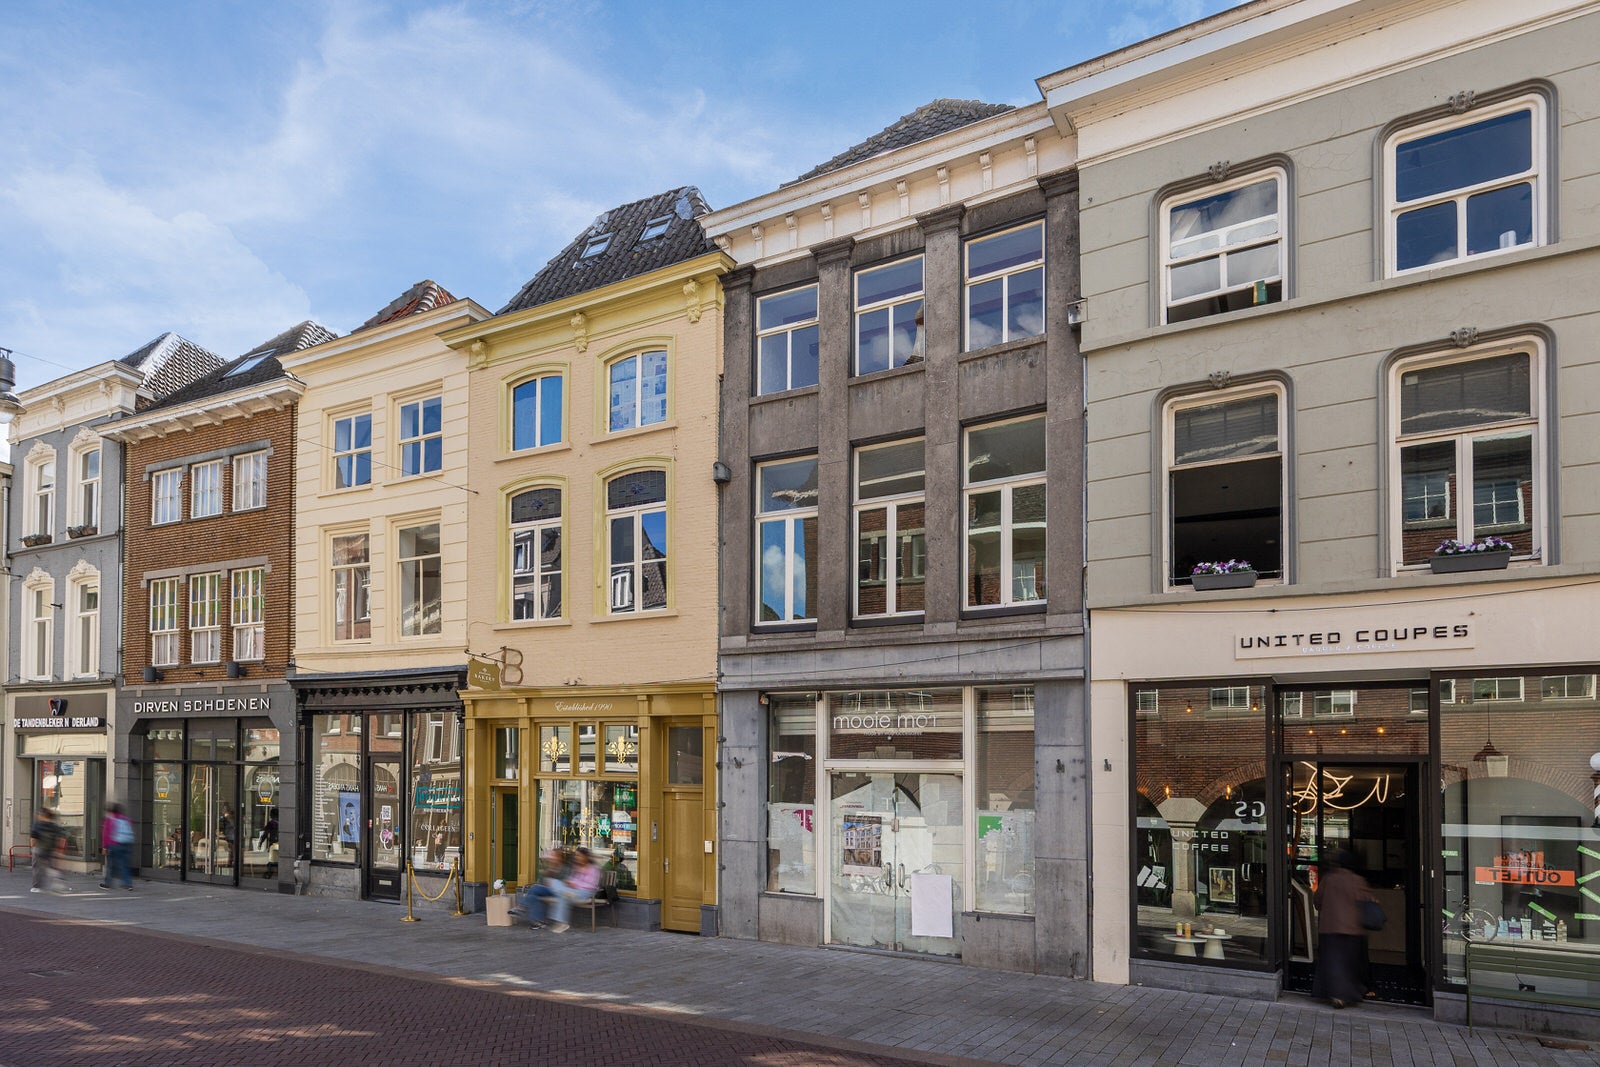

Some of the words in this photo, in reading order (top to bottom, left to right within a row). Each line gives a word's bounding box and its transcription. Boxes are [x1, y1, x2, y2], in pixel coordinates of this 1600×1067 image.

[1240, 631, 1341, 649] UNITED
[1355, 625, 1468, 643] COUPES
[134, 701, 179, 713] DIRVEN
[183, 698, 271, 712] SCHOENEN
[554, 701, 594, 712] Established
[14, 718, 21, 728] DE
[21, 717, 65, 728] TANDENBLEKER
[833, 711, 891, 729] mooie
[1171, 830, 1229, 839] UNITED
[1172, 843, 1229, 852] COFFEE
